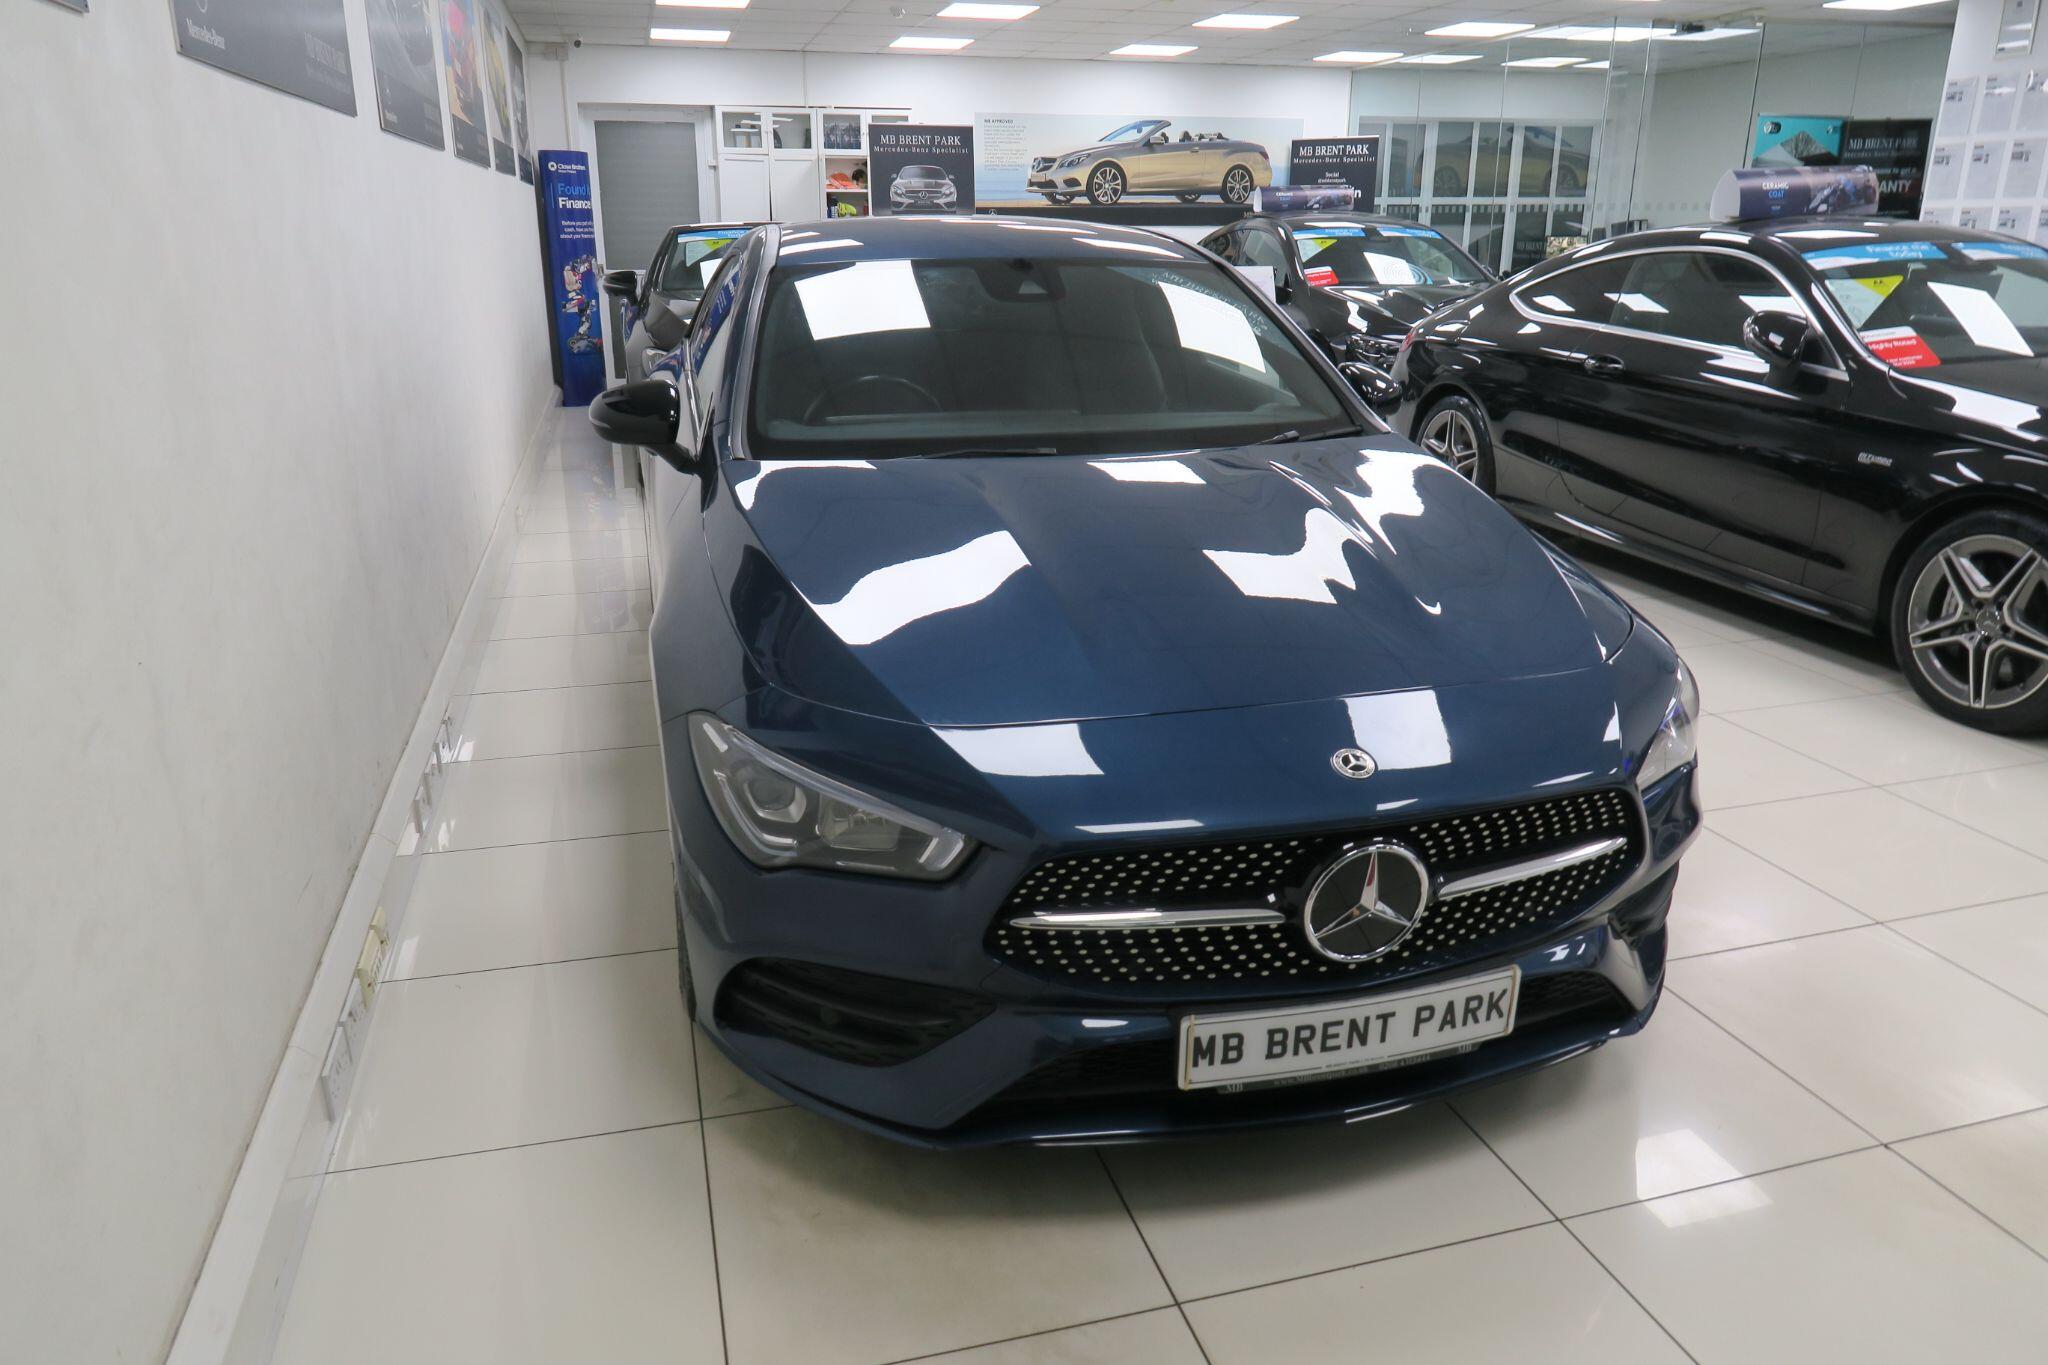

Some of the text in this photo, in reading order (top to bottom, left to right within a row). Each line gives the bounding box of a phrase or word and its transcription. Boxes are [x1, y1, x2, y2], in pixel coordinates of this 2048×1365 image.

[880, 134, 961, 146] MB BRENT PARK
[1865, 137, 1894, 149] BRENT
[873, 145, 969, 154] Mercedes-Benz Specialist
[1299, 144, 1369, 156] MB BRENT PARK
[557, 183, 586, 196] Found
[1762, 182, 1789, 191] CERAMIC
[1879, 179, 1912, 193] ANTY
[1768, 190, 1785, 199] COAT
[558, 196, 592, 209] Finance
[1191, 987, 1508, 1069] MB BRENT PARK
